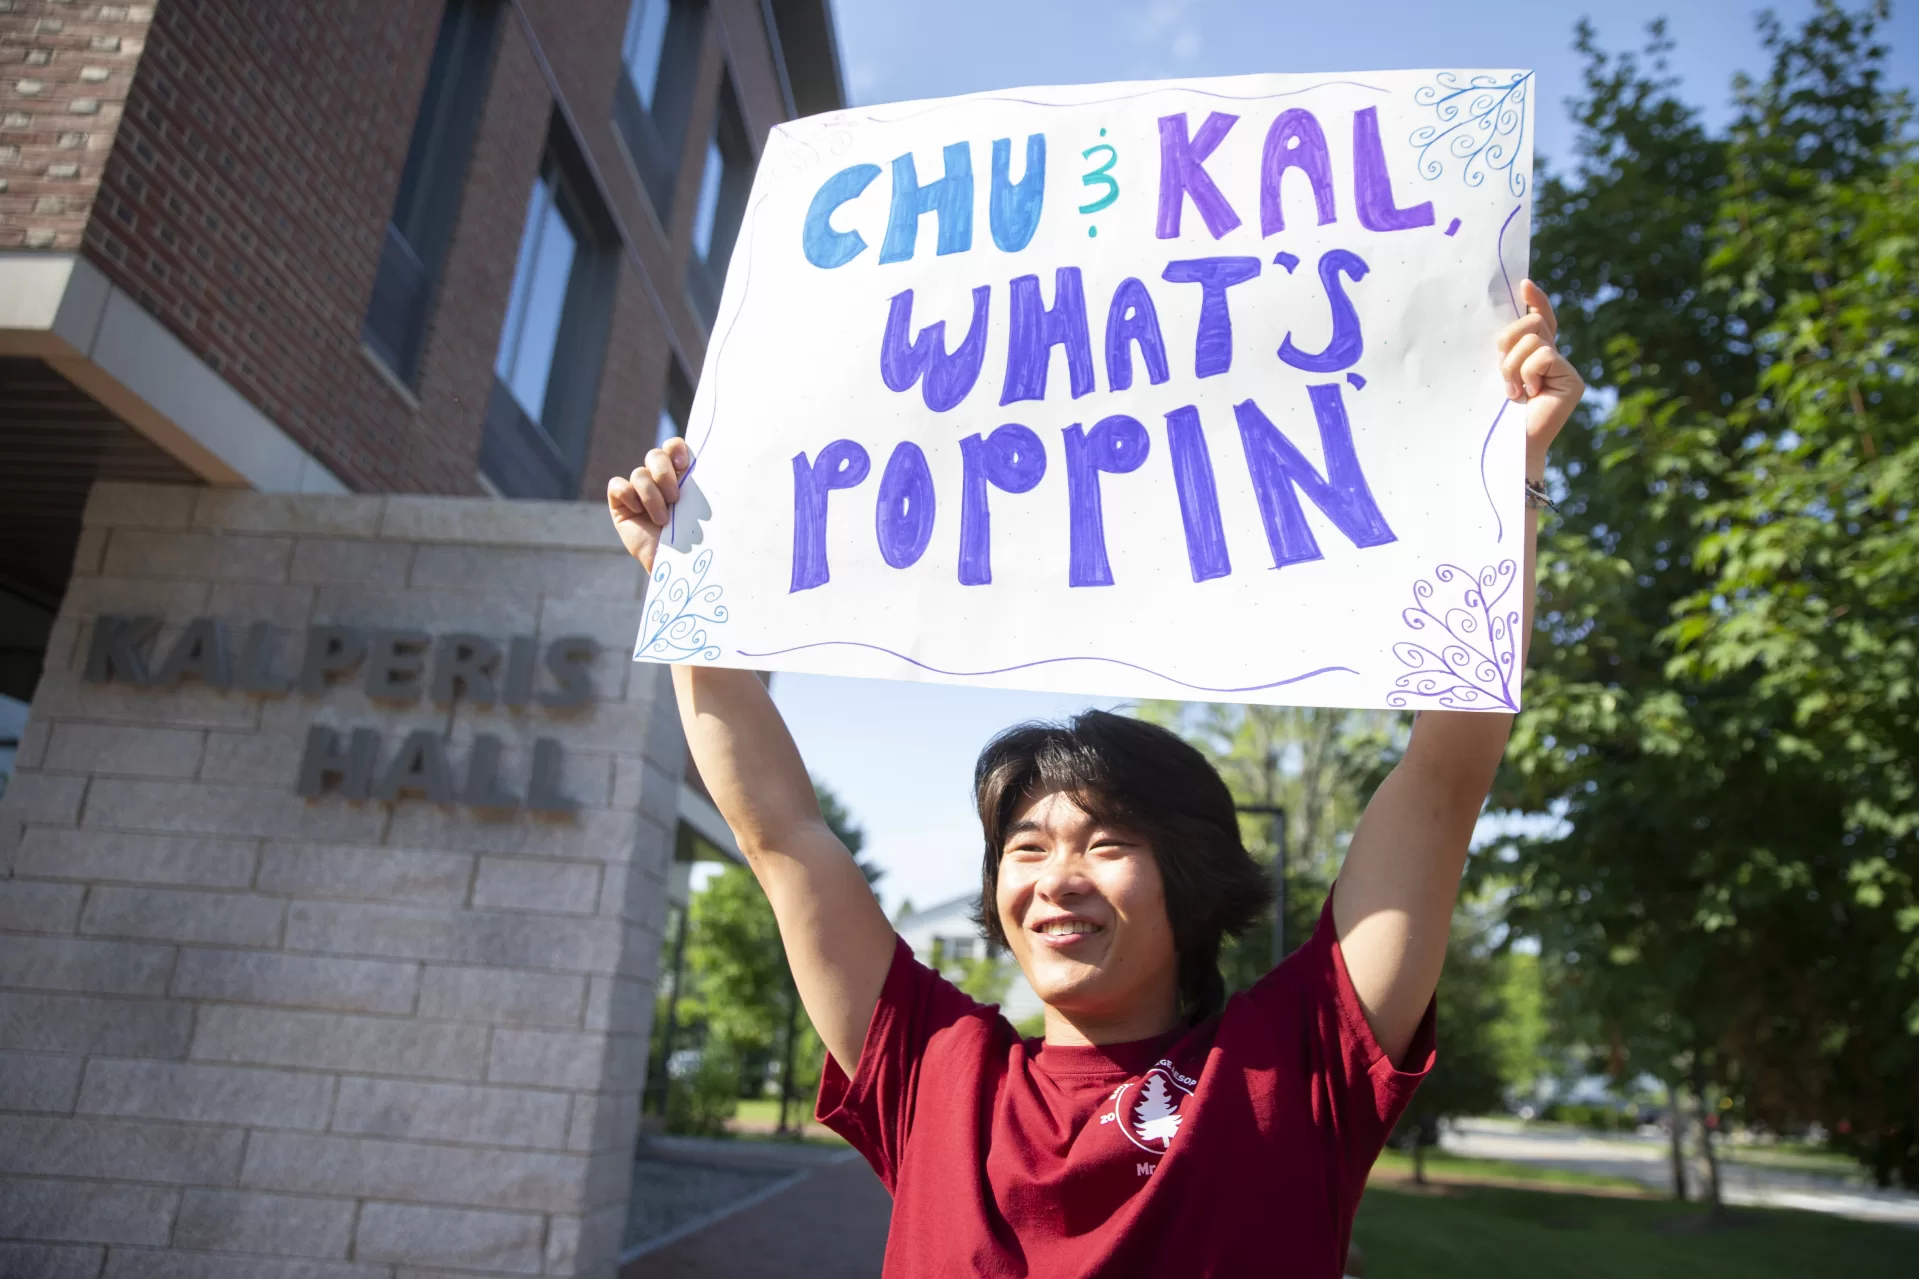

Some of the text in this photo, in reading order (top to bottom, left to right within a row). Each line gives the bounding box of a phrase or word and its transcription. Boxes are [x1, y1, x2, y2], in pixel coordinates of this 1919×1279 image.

[802, 133, 1047, 269] CHU
[1155, 106, 1462, 240] KAL,
[880, 249, 1370, 412] WHAT'S
[84, 614, 602, 714] KALPERIS
[298, 724, 584, 820] HALL
